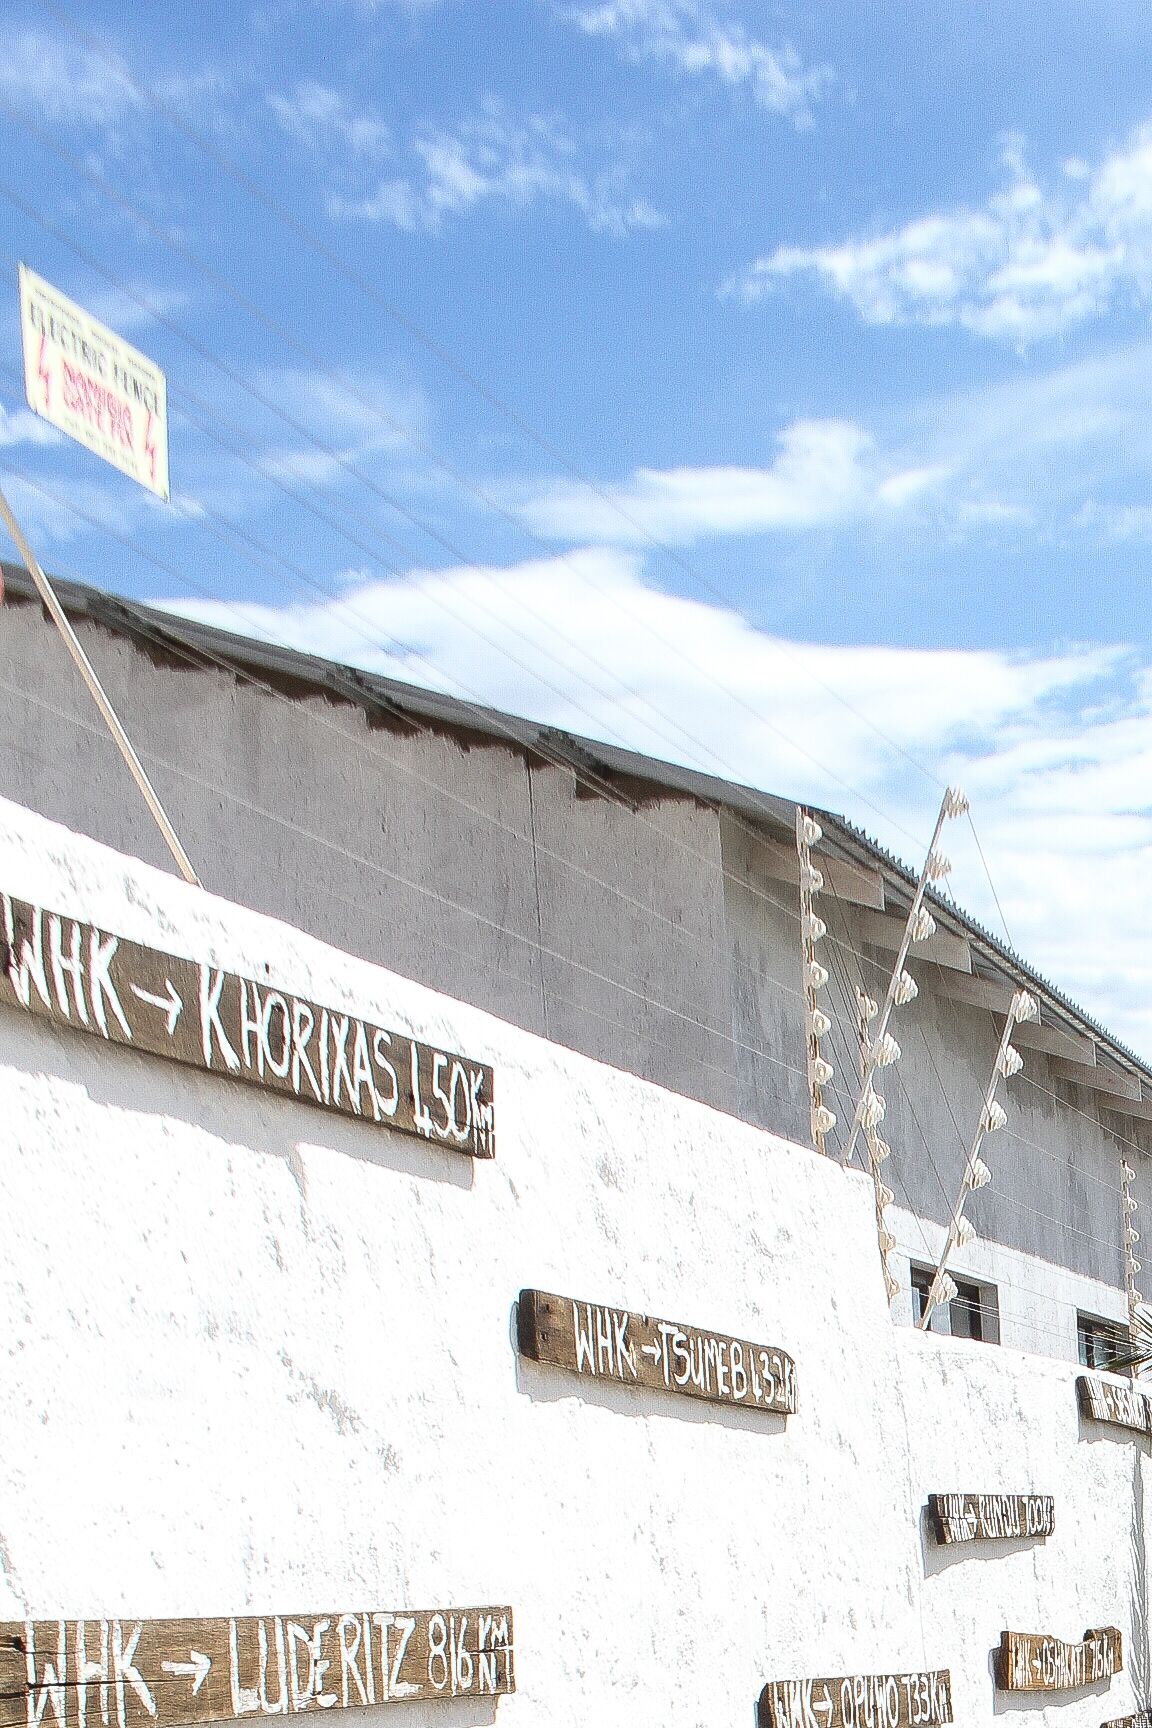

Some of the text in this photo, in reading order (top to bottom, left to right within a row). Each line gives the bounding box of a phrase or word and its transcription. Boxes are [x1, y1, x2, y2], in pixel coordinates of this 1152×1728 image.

[4, 895, 133, 1040] WHK
[201, 964, 399, 1121] KHORIXAS
[572, 1301, 638, 1379] WHK
[657, 1321, 747, 1400] TSUMEB
[228, 1611, 424, 1718] LUDERITZ
